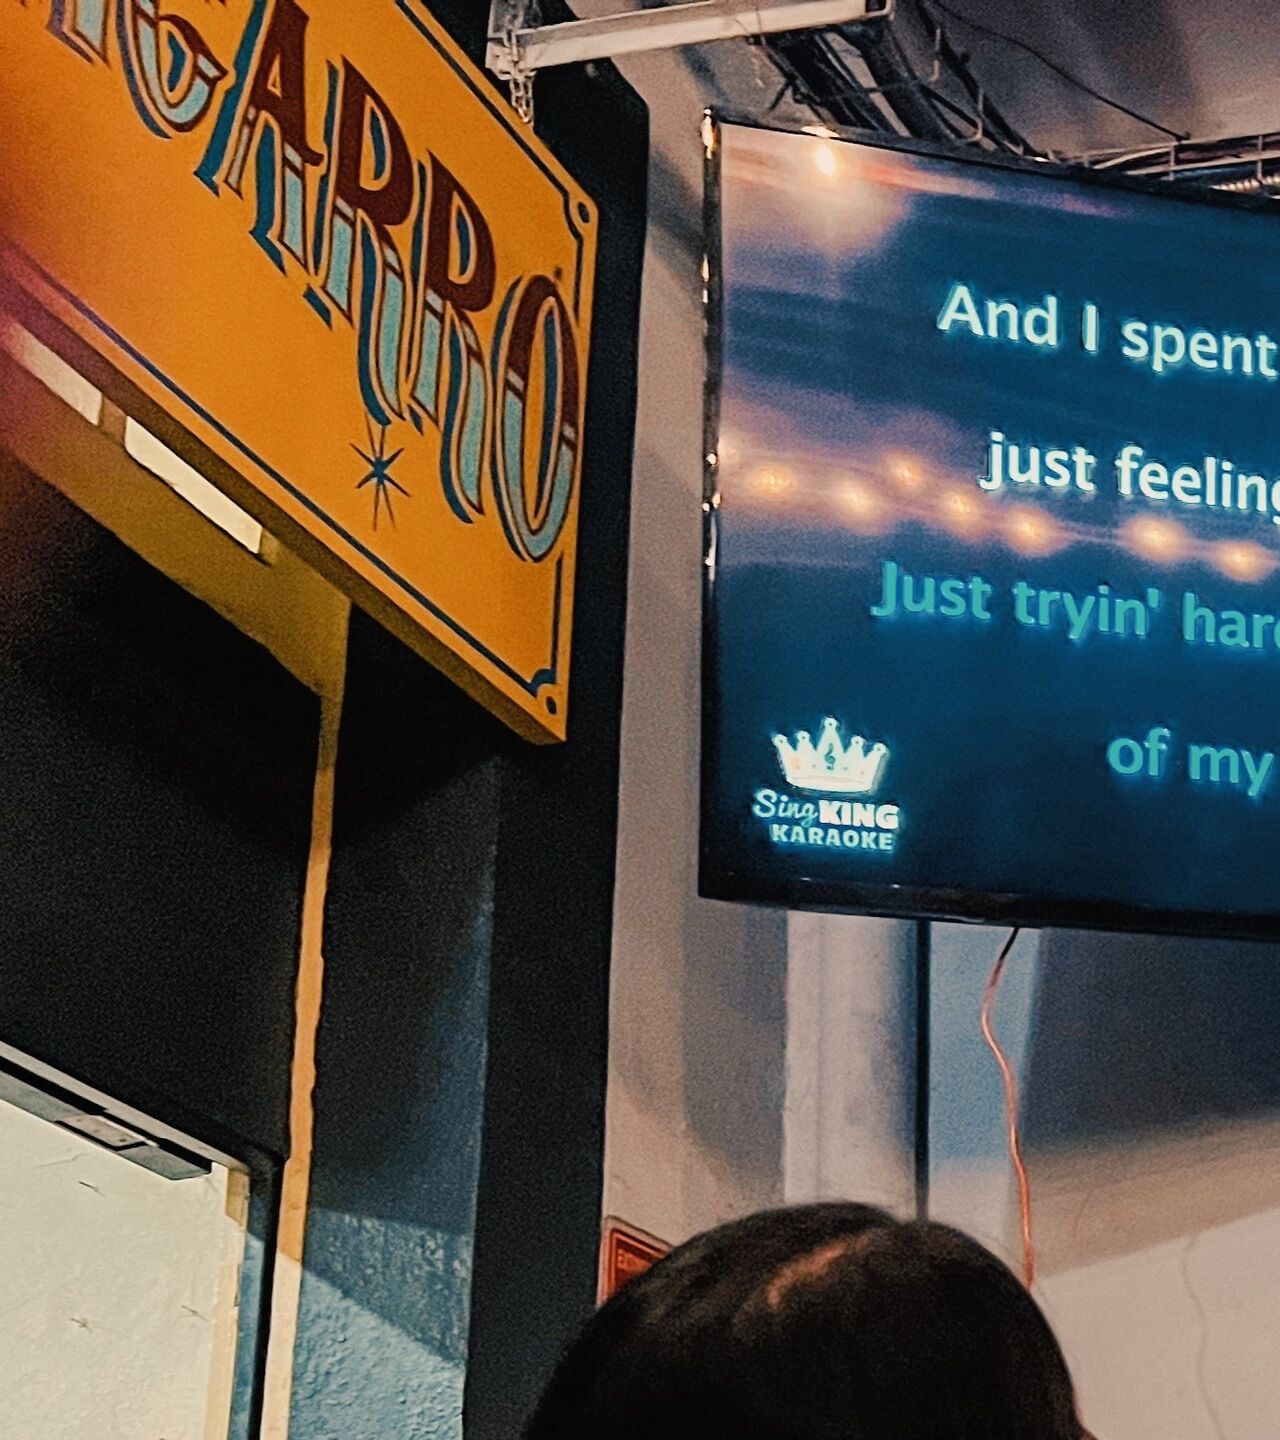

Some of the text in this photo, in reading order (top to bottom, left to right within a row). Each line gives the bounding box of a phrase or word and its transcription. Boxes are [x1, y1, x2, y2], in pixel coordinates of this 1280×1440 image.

[45, 0, 580, 564] GARRO
[937, 284, 1058, 348] And
[1082, 303, 1099, 353] I
[1121, 317, 1278, 377] spent
[979, 430, 1097, 494] just
[870, 561, 993, 621] Just
[1014, 580, 1162, 641] tryin'
[1107, 726, 1170, 776] of
[1189, 744, 1274, 798] my
[752, 789, 900, 829] Sing KING
[771, 823, 894, 850] KARAOKE
